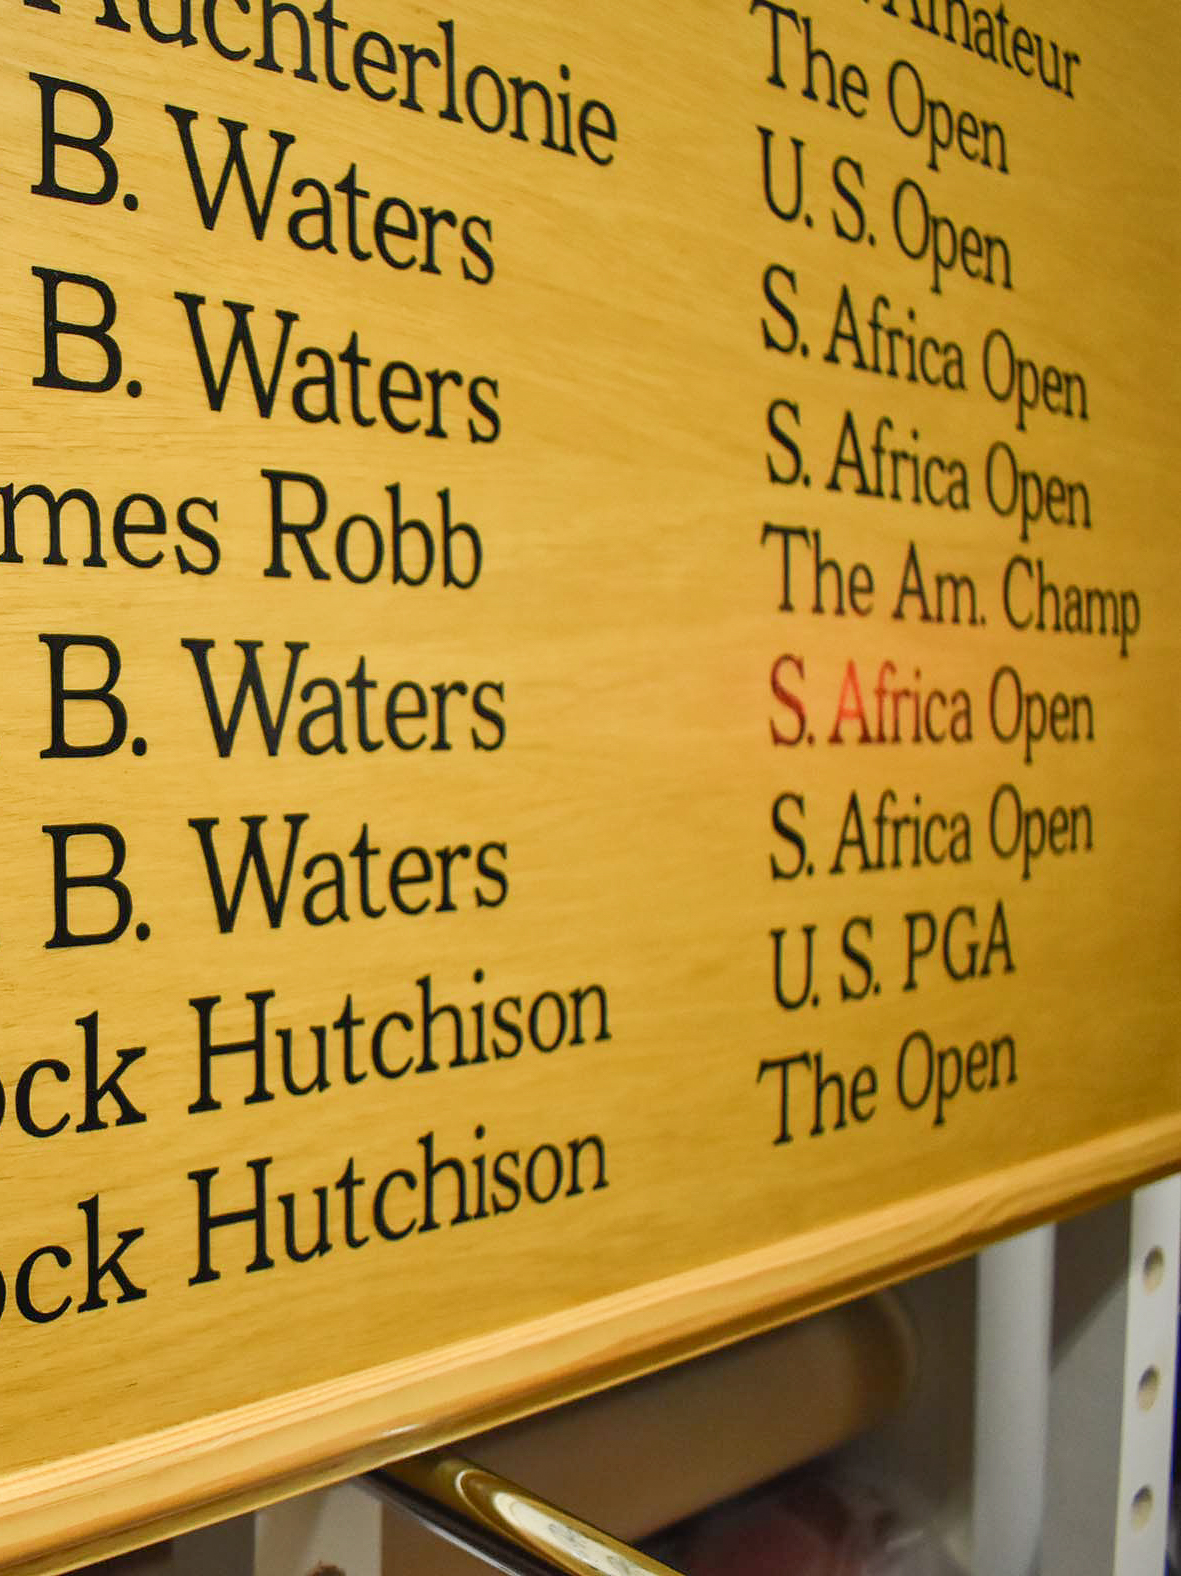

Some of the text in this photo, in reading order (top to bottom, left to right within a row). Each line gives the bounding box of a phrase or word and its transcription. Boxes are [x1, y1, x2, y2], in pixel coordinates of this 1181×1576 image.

[24, 0, 617, 166] uchterlonie
[749, 0, 1011, 175] The Open
[881, 0, 1081, 100] mateur
[28, 71, 139, 212] B.
[163, 103, 496, 286] Waters
[756, 125, 1014, 295] U. S. Open
[30, 265, 144, 400] B.
[173, 291, 502, 444] Waters
[761, 264, 1089, 432] S. Africa Open
[260, 468, 484, 590] Robb
[765, 398, 1093, 543] S. Africa Open
[761, 522, 1142, 660] The Am. Champ
[37, 633, 150, 758] B.
[180, 637, 508, 759] Waters
[770, 654, 1096, 766] S. Africa Open
[41, 822, 152, 950] B.
[187, 813, 509, 935] Waters
[769, 784, 1094, 881] S. Africa Open
[769, 900, 1017, 1011] U. S. PGA
[187, 968, 612, 1116] Hutchison
[756, 1029, 1019, 1147] The Open
[187, 1125, 610, 1288] Hutchison
